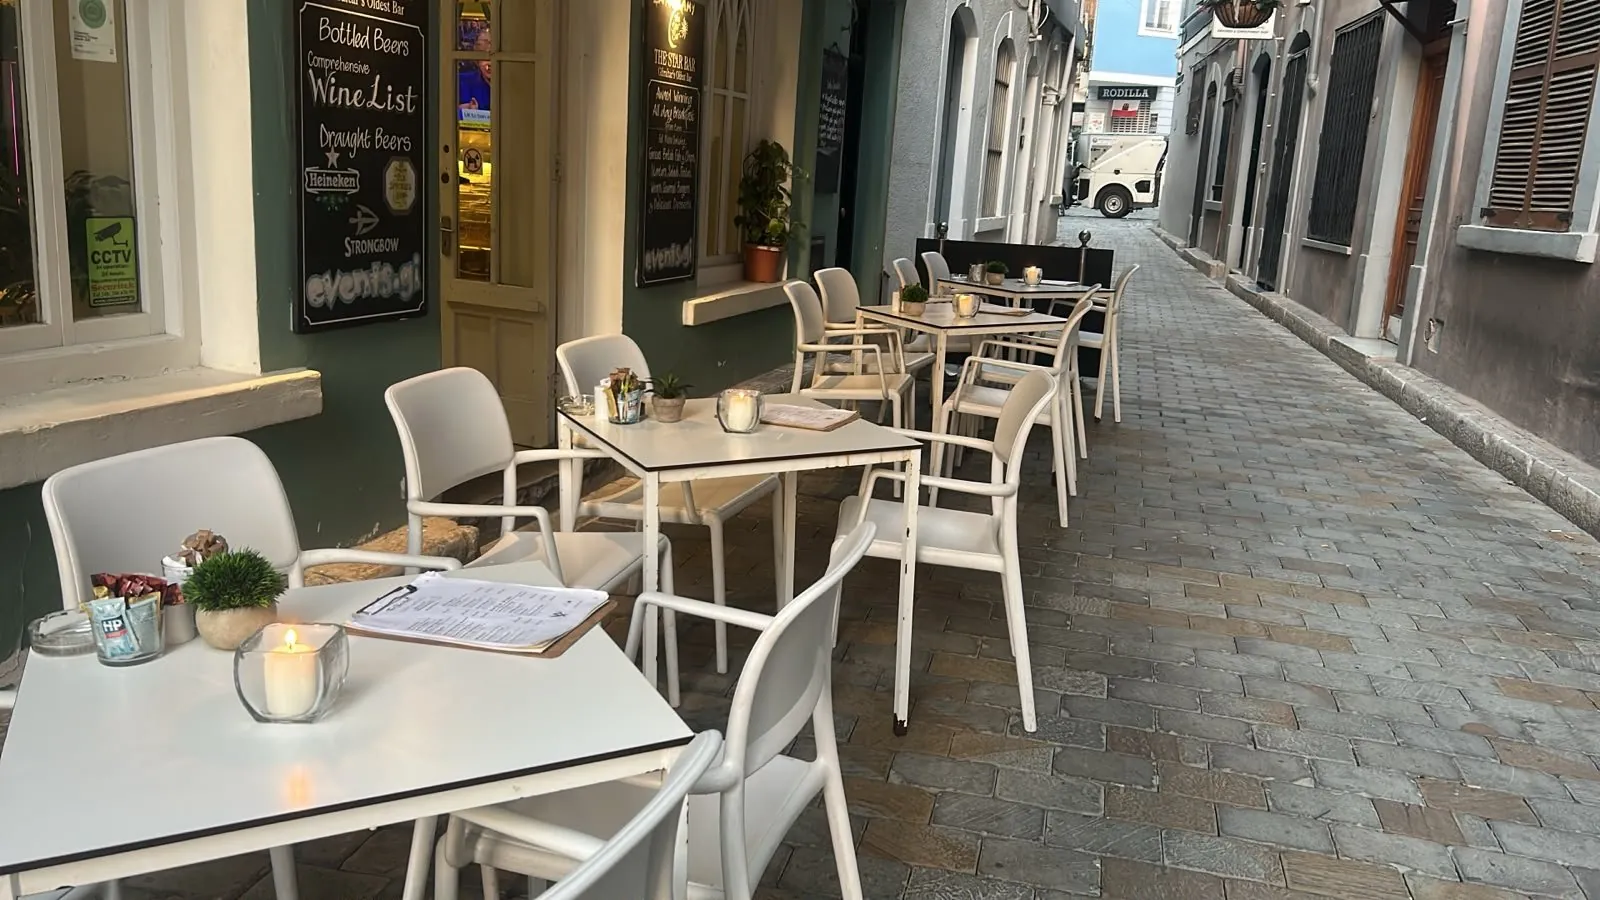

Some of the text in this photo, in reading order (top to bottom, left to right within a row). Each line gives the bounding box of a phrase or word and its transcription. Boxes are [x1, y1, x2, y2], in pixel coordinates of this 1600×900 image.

[392, 0, 405, 15] Bar
[319, 17, 409, 57] Bottled Beers
[307, 50, 370, 76] Comprehensive
[653, 48, 696, 73] THE STAR BAR
[308, 68, 418, 113] Wine List
[1102, 88, 1149, 98] RODILLA
[319, 123, 412, 158] Draught Beers
[309, 172, 356, 188] Heineken
[91, 249, 132, 265] CCTV
[344, 236, 400, 258] STRONGBOW
[103, 619, 123, 633] HP
